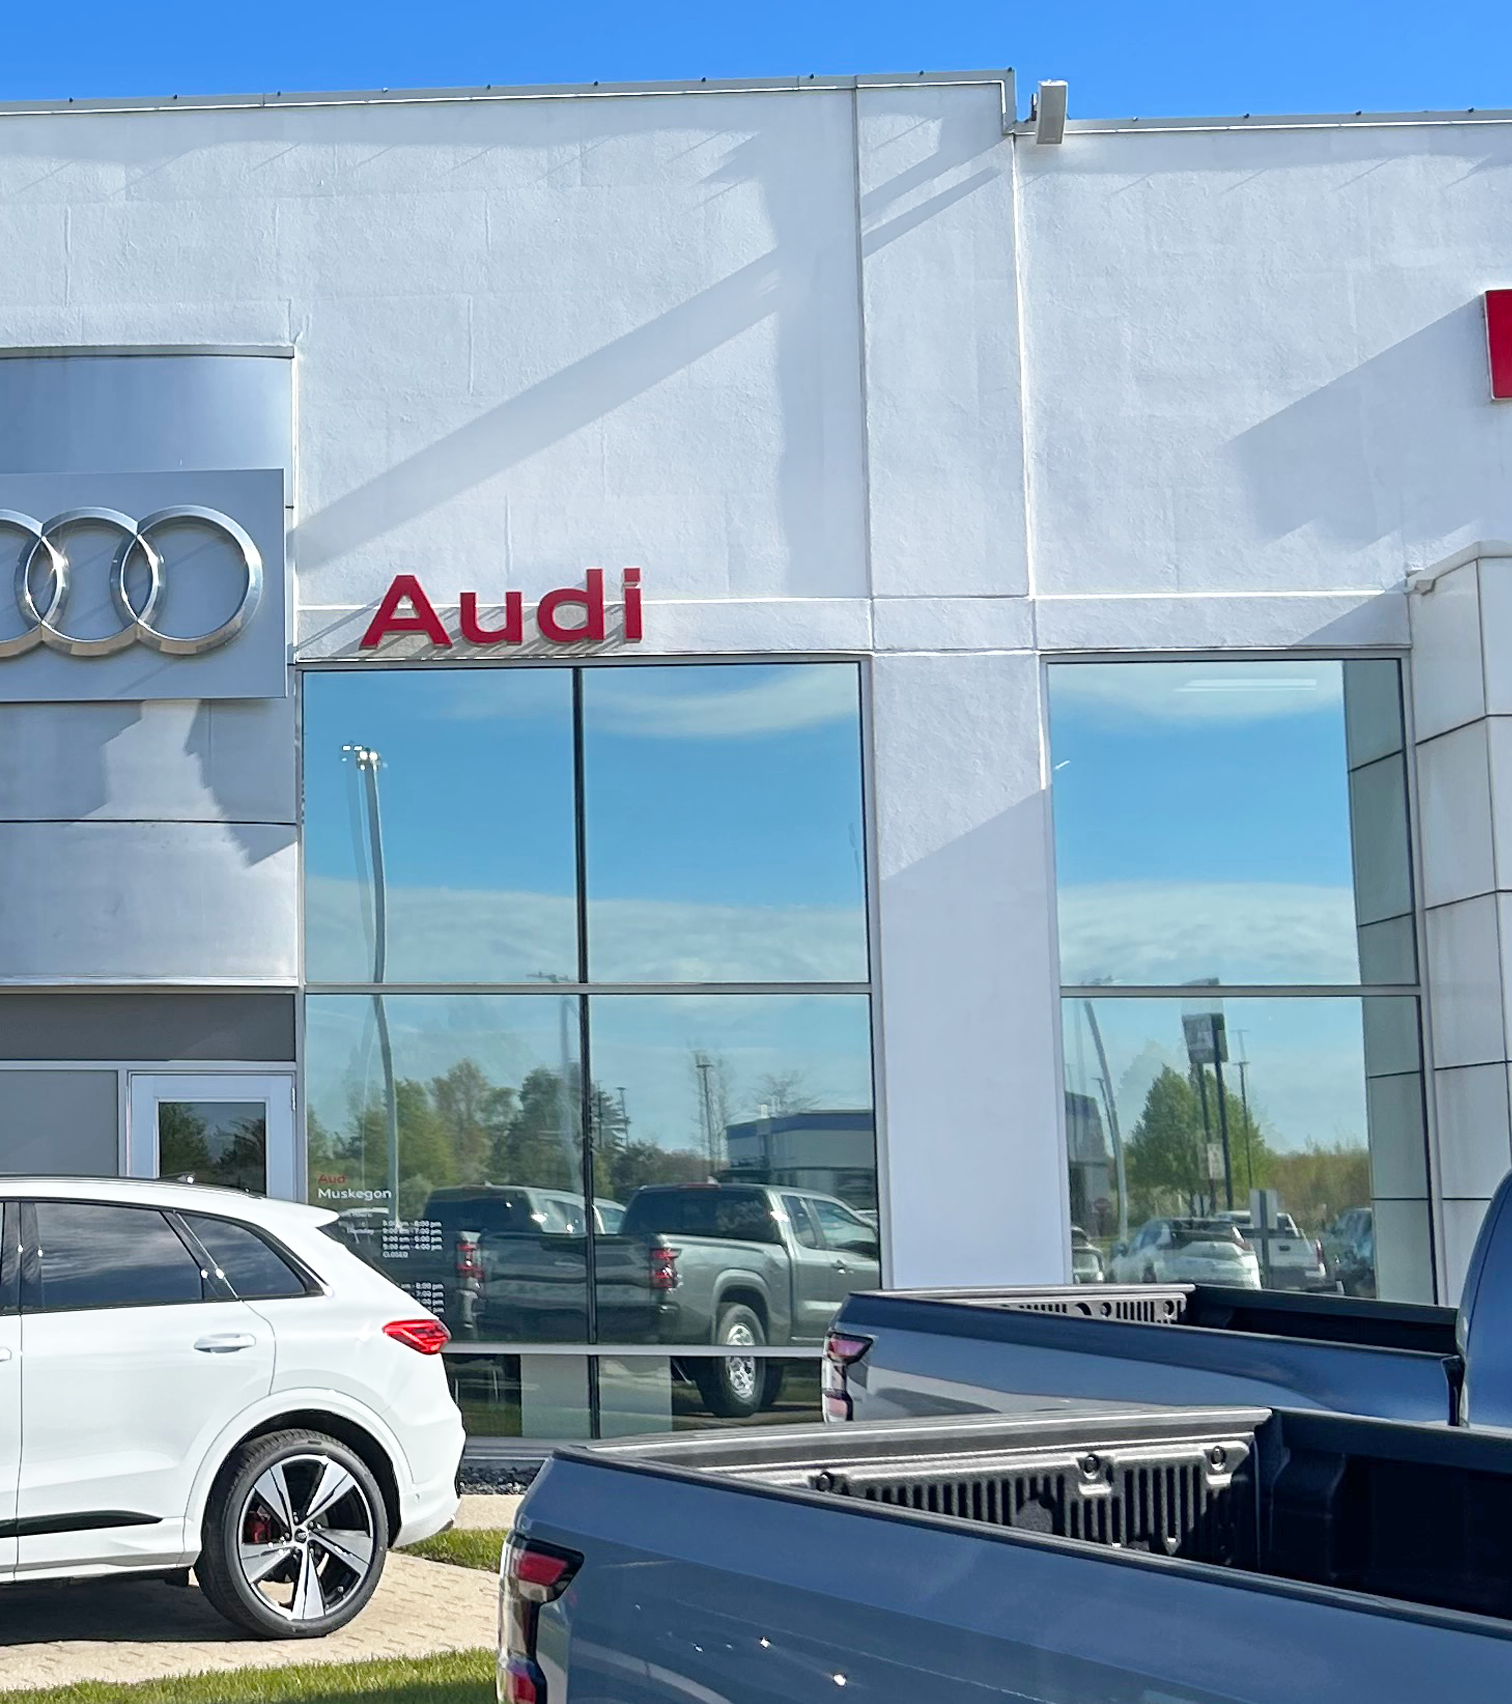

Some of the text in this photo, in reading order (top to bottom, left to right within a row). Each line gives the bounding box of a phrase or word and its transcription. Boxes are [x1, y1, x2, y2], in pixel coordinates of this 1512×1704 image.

[359, 567, 643, 650] Audi
[317, 1173, 349, 1185] Aud
[317, 1187, 392, 1201] Muskegon
[430, 1228, 443, 1236] pm
[382, 1250, 409, 1259] CLOSED
[432, 1283, 444, 1291] pm
[432, 1291, 444, 1299] pm
